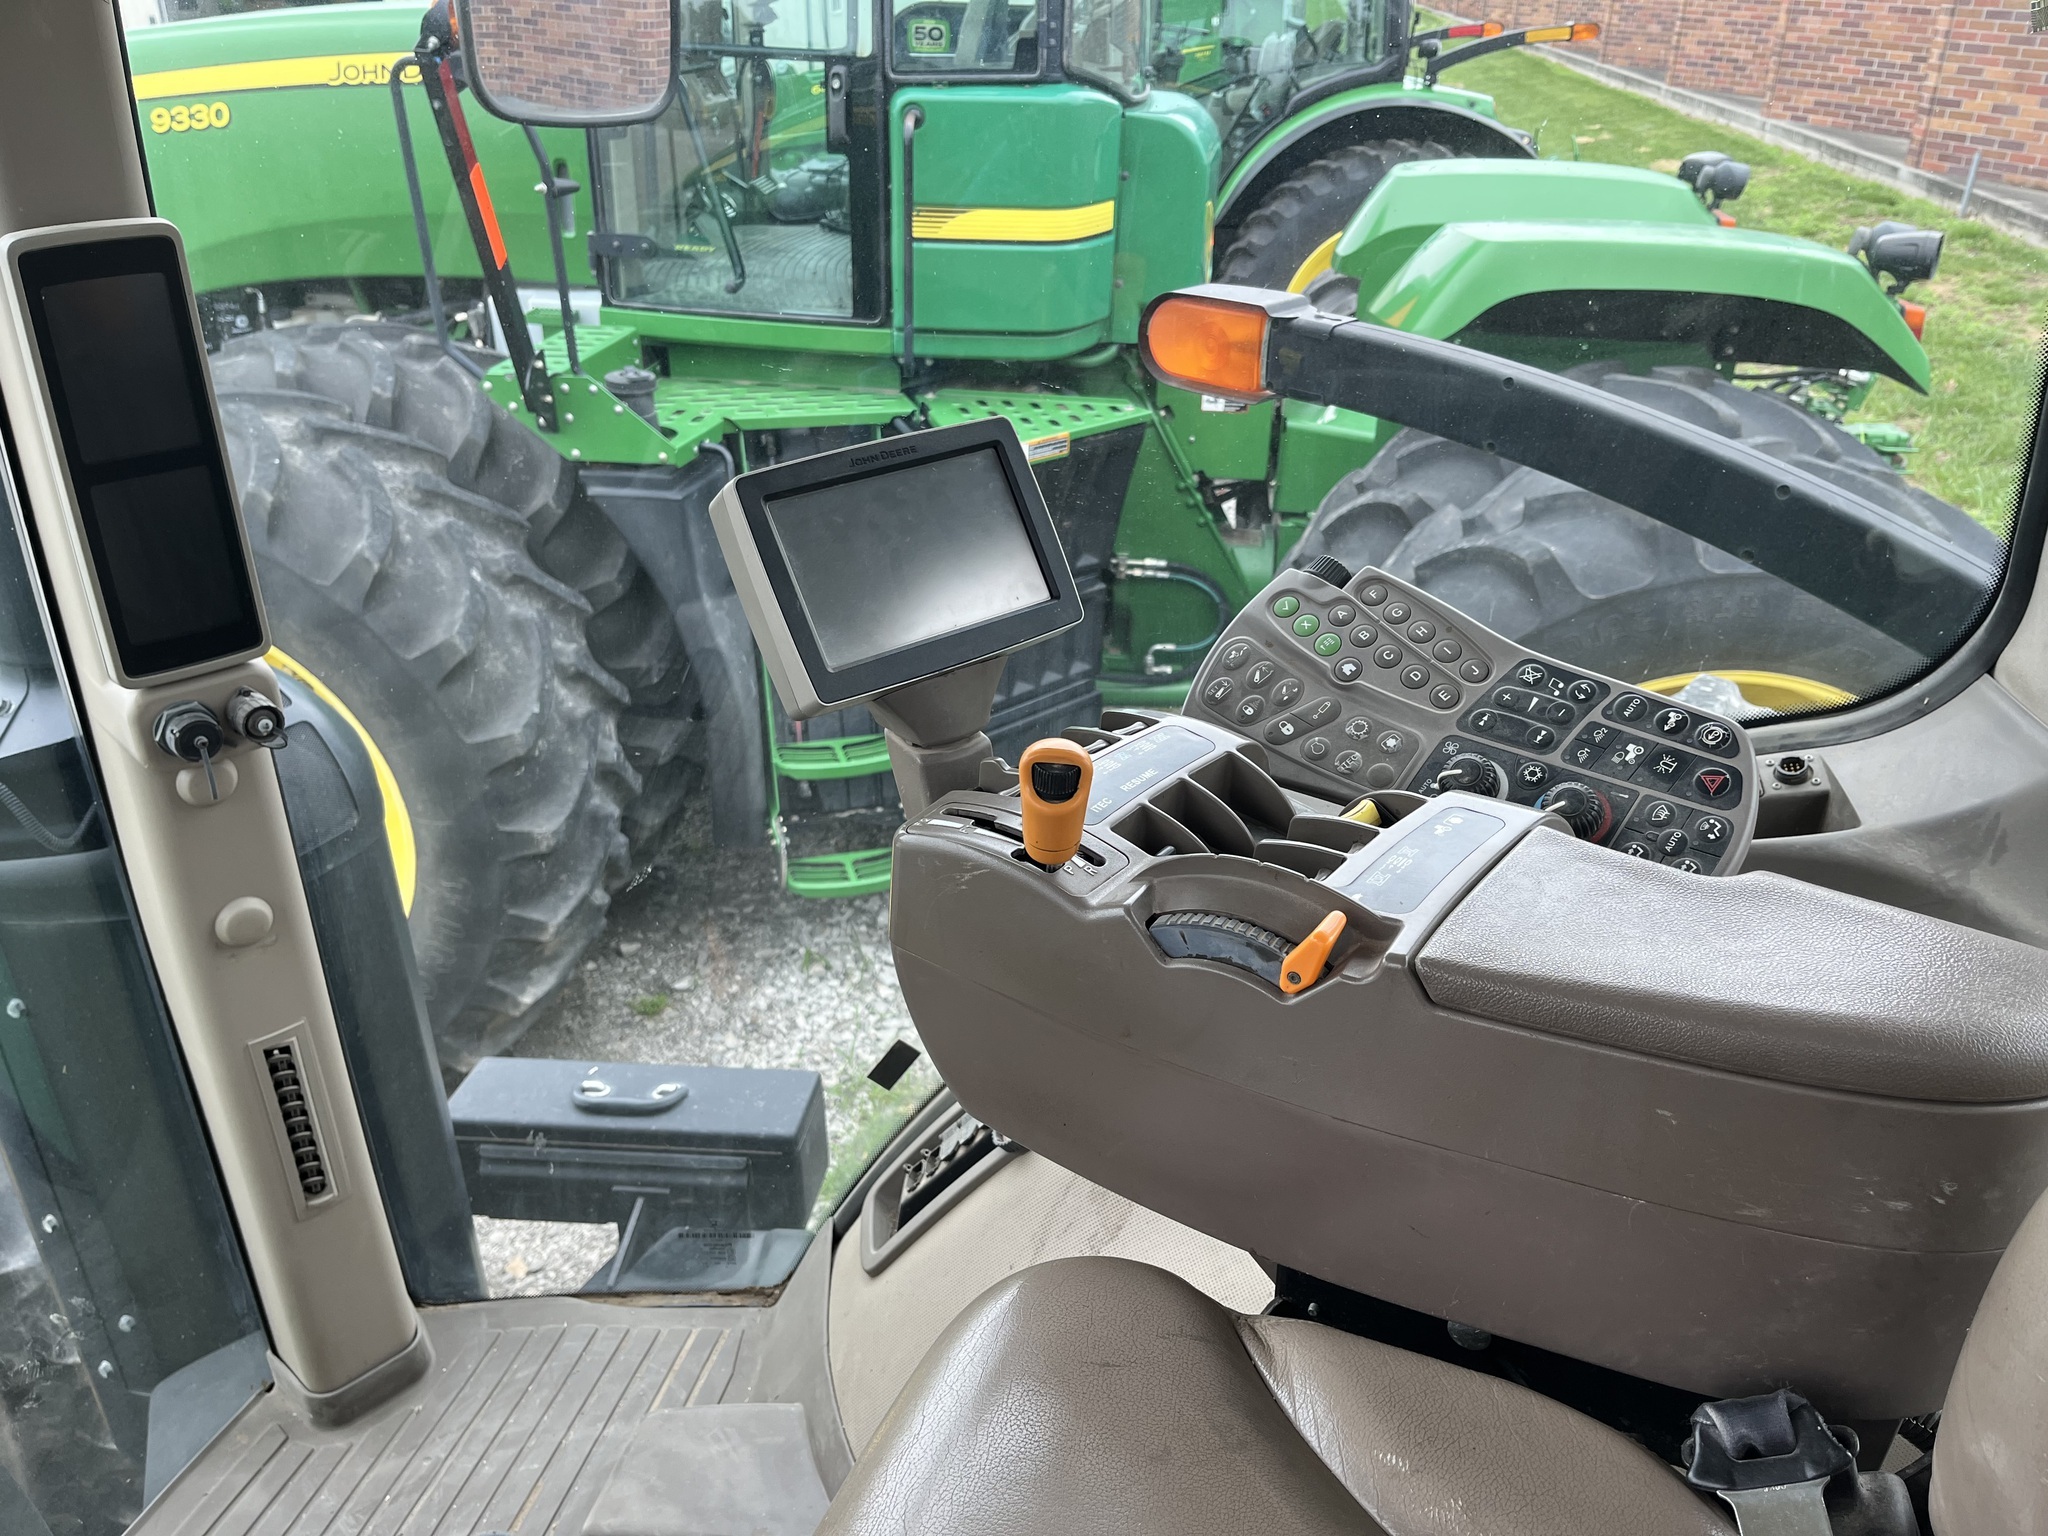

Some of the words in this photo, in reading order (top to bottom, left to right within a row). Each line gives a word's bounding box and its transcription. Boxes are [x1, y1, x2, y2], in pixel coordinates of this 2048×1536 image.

[914, 26, 943, 41] 50
[328, 61, 392, 82] JOHN
[150, 101, 231, 134] 9330
[848, 454, 879, 468] JOHN
[879, 445, 918, 460] DEERE
[1368, 589, 1378, 599] F
[1334, 609, 1348, 621] A
[1391, 608, 1403, 617] G
[1358, 630, 1370, 640] B
[1415, 626, 1428, 637] H
[1382, 650, 1394, 660] C
[1471, 665, 1480, 675] J
[1409, 671, 1422, 681] D
[1438, 690, 1451, 701] E
[1623, 698, 1641, 717] AUTO
[1119, 768, 1158, 792] RESUME
[1418, 778, 1432, 794] AUTO
[1664, 831, 1682, 853] AUTO
[1064, 865, 1075, 875] P
[1084, 865, 1098, 876] R
